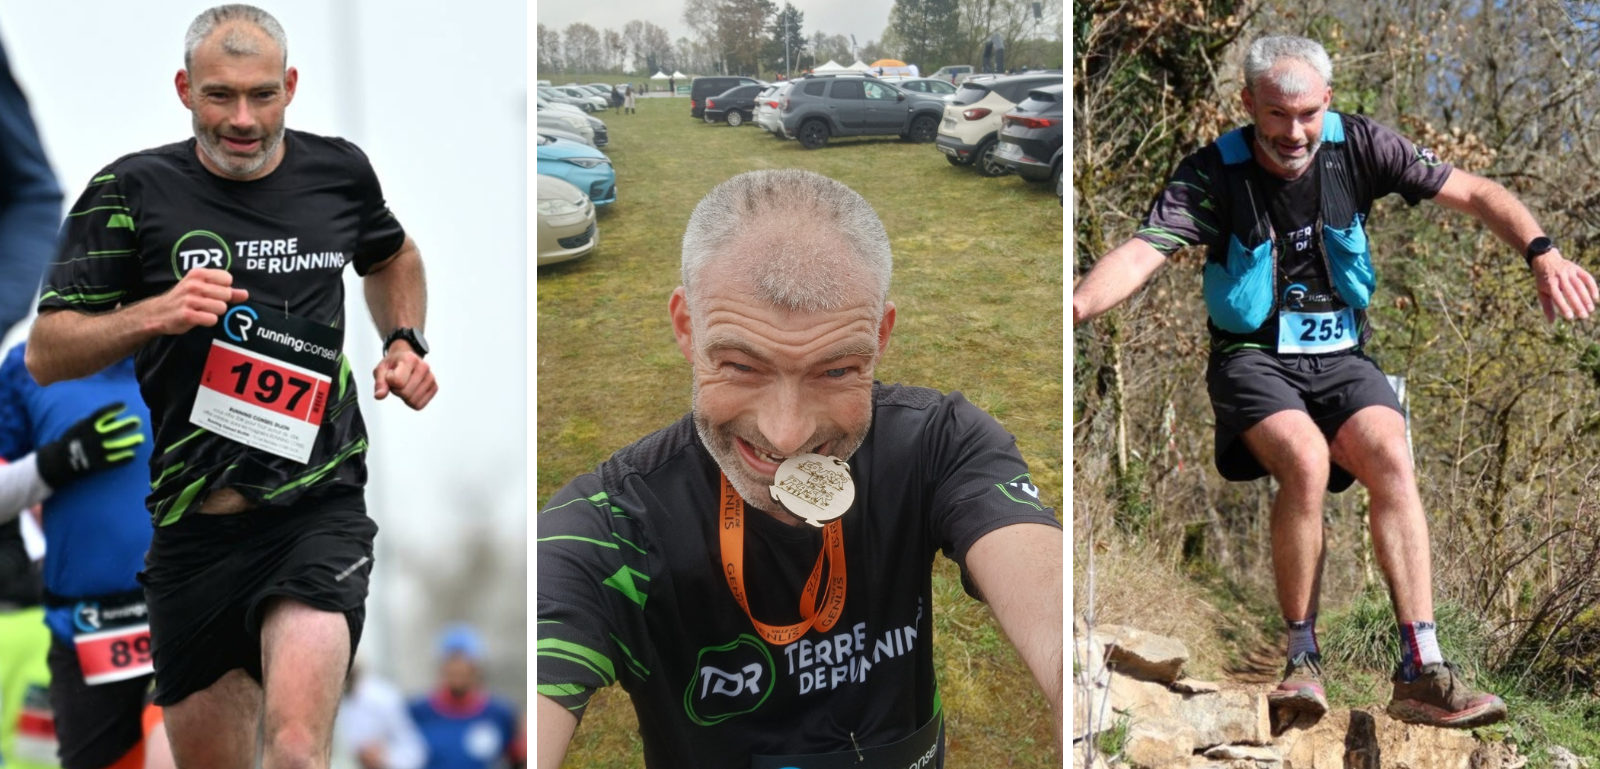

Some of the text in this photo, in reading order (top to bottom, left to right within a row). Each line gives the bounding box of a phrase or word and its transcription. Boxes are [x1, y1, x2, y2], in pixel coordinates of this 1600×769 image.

[235, 238, 298, 257] TERRE
[1287, 225, 1313, 242] TER
[246, 252, 345, 274] DE RUNNING
[1300, 316, 1344, 341] 255
[230, 361, 312, 411] 197
[725, 480, 735, 530] ENLIS
[822, 576, 844, 627] GENLIS
[784, 622, 866, 675] TERRE
[799, 666, 827, 695] DE
